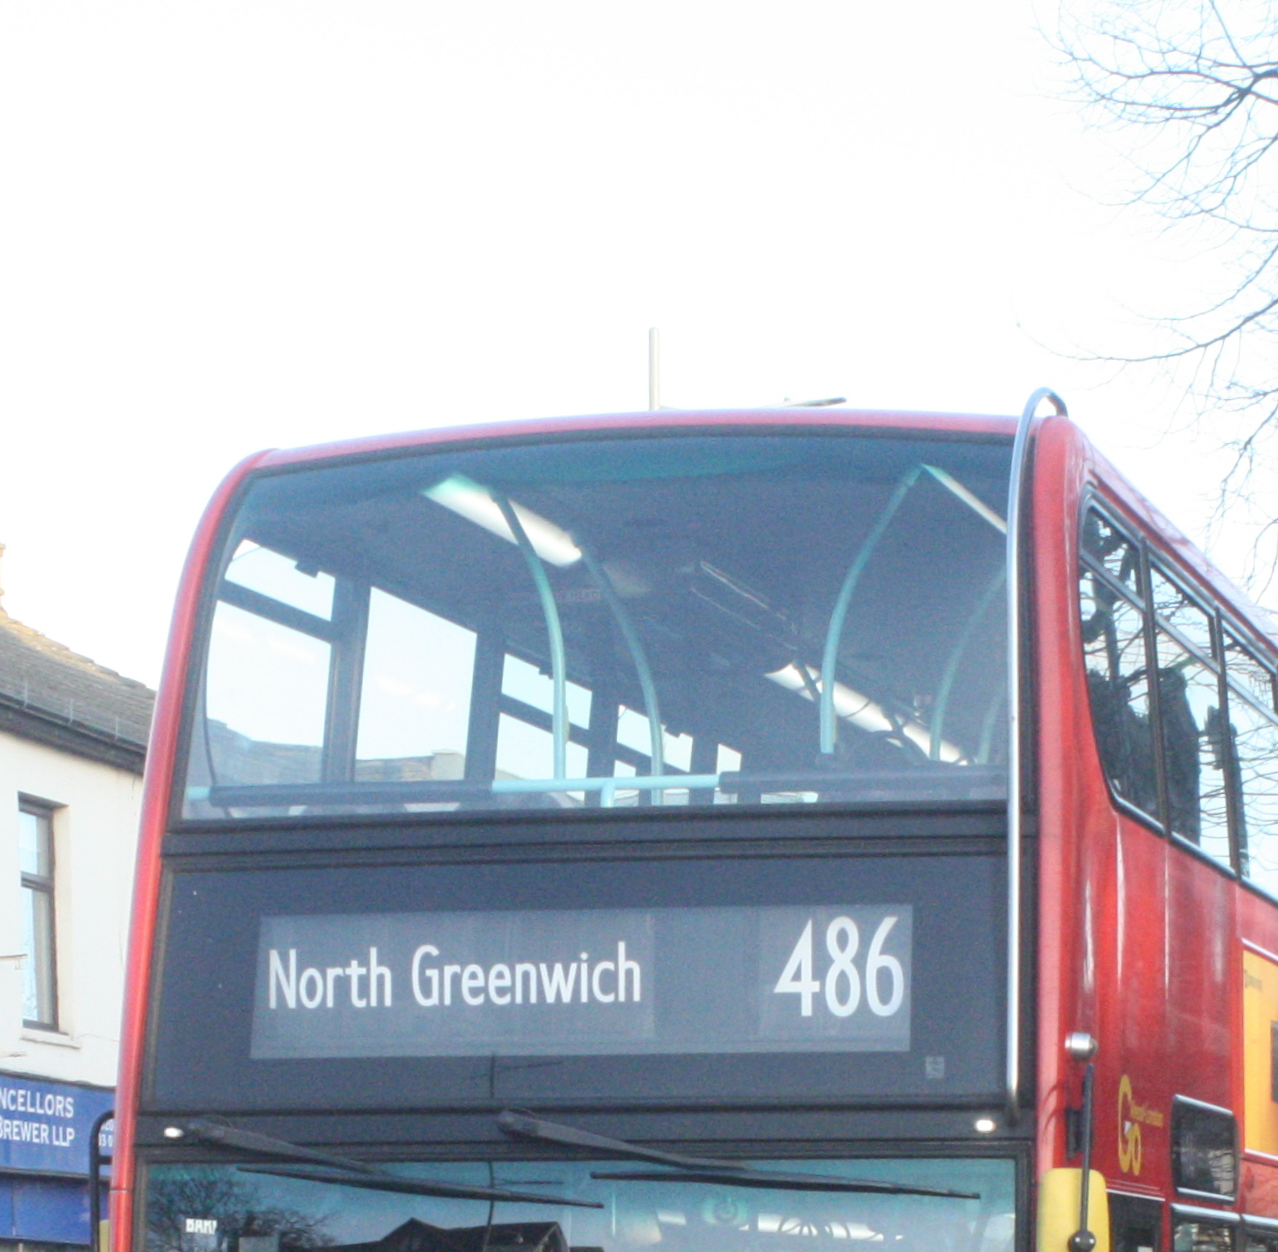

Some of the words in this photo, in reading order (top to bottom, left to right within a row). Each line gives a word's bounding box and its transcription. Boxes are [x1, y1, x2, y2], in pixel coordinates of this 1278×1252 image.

[268, 947, 393, 1009] North
[411, 941, 642, 1007] Greenwich
[773, 916, 904, 1017] 486
[52, 1125, 75, 1147] LLP
